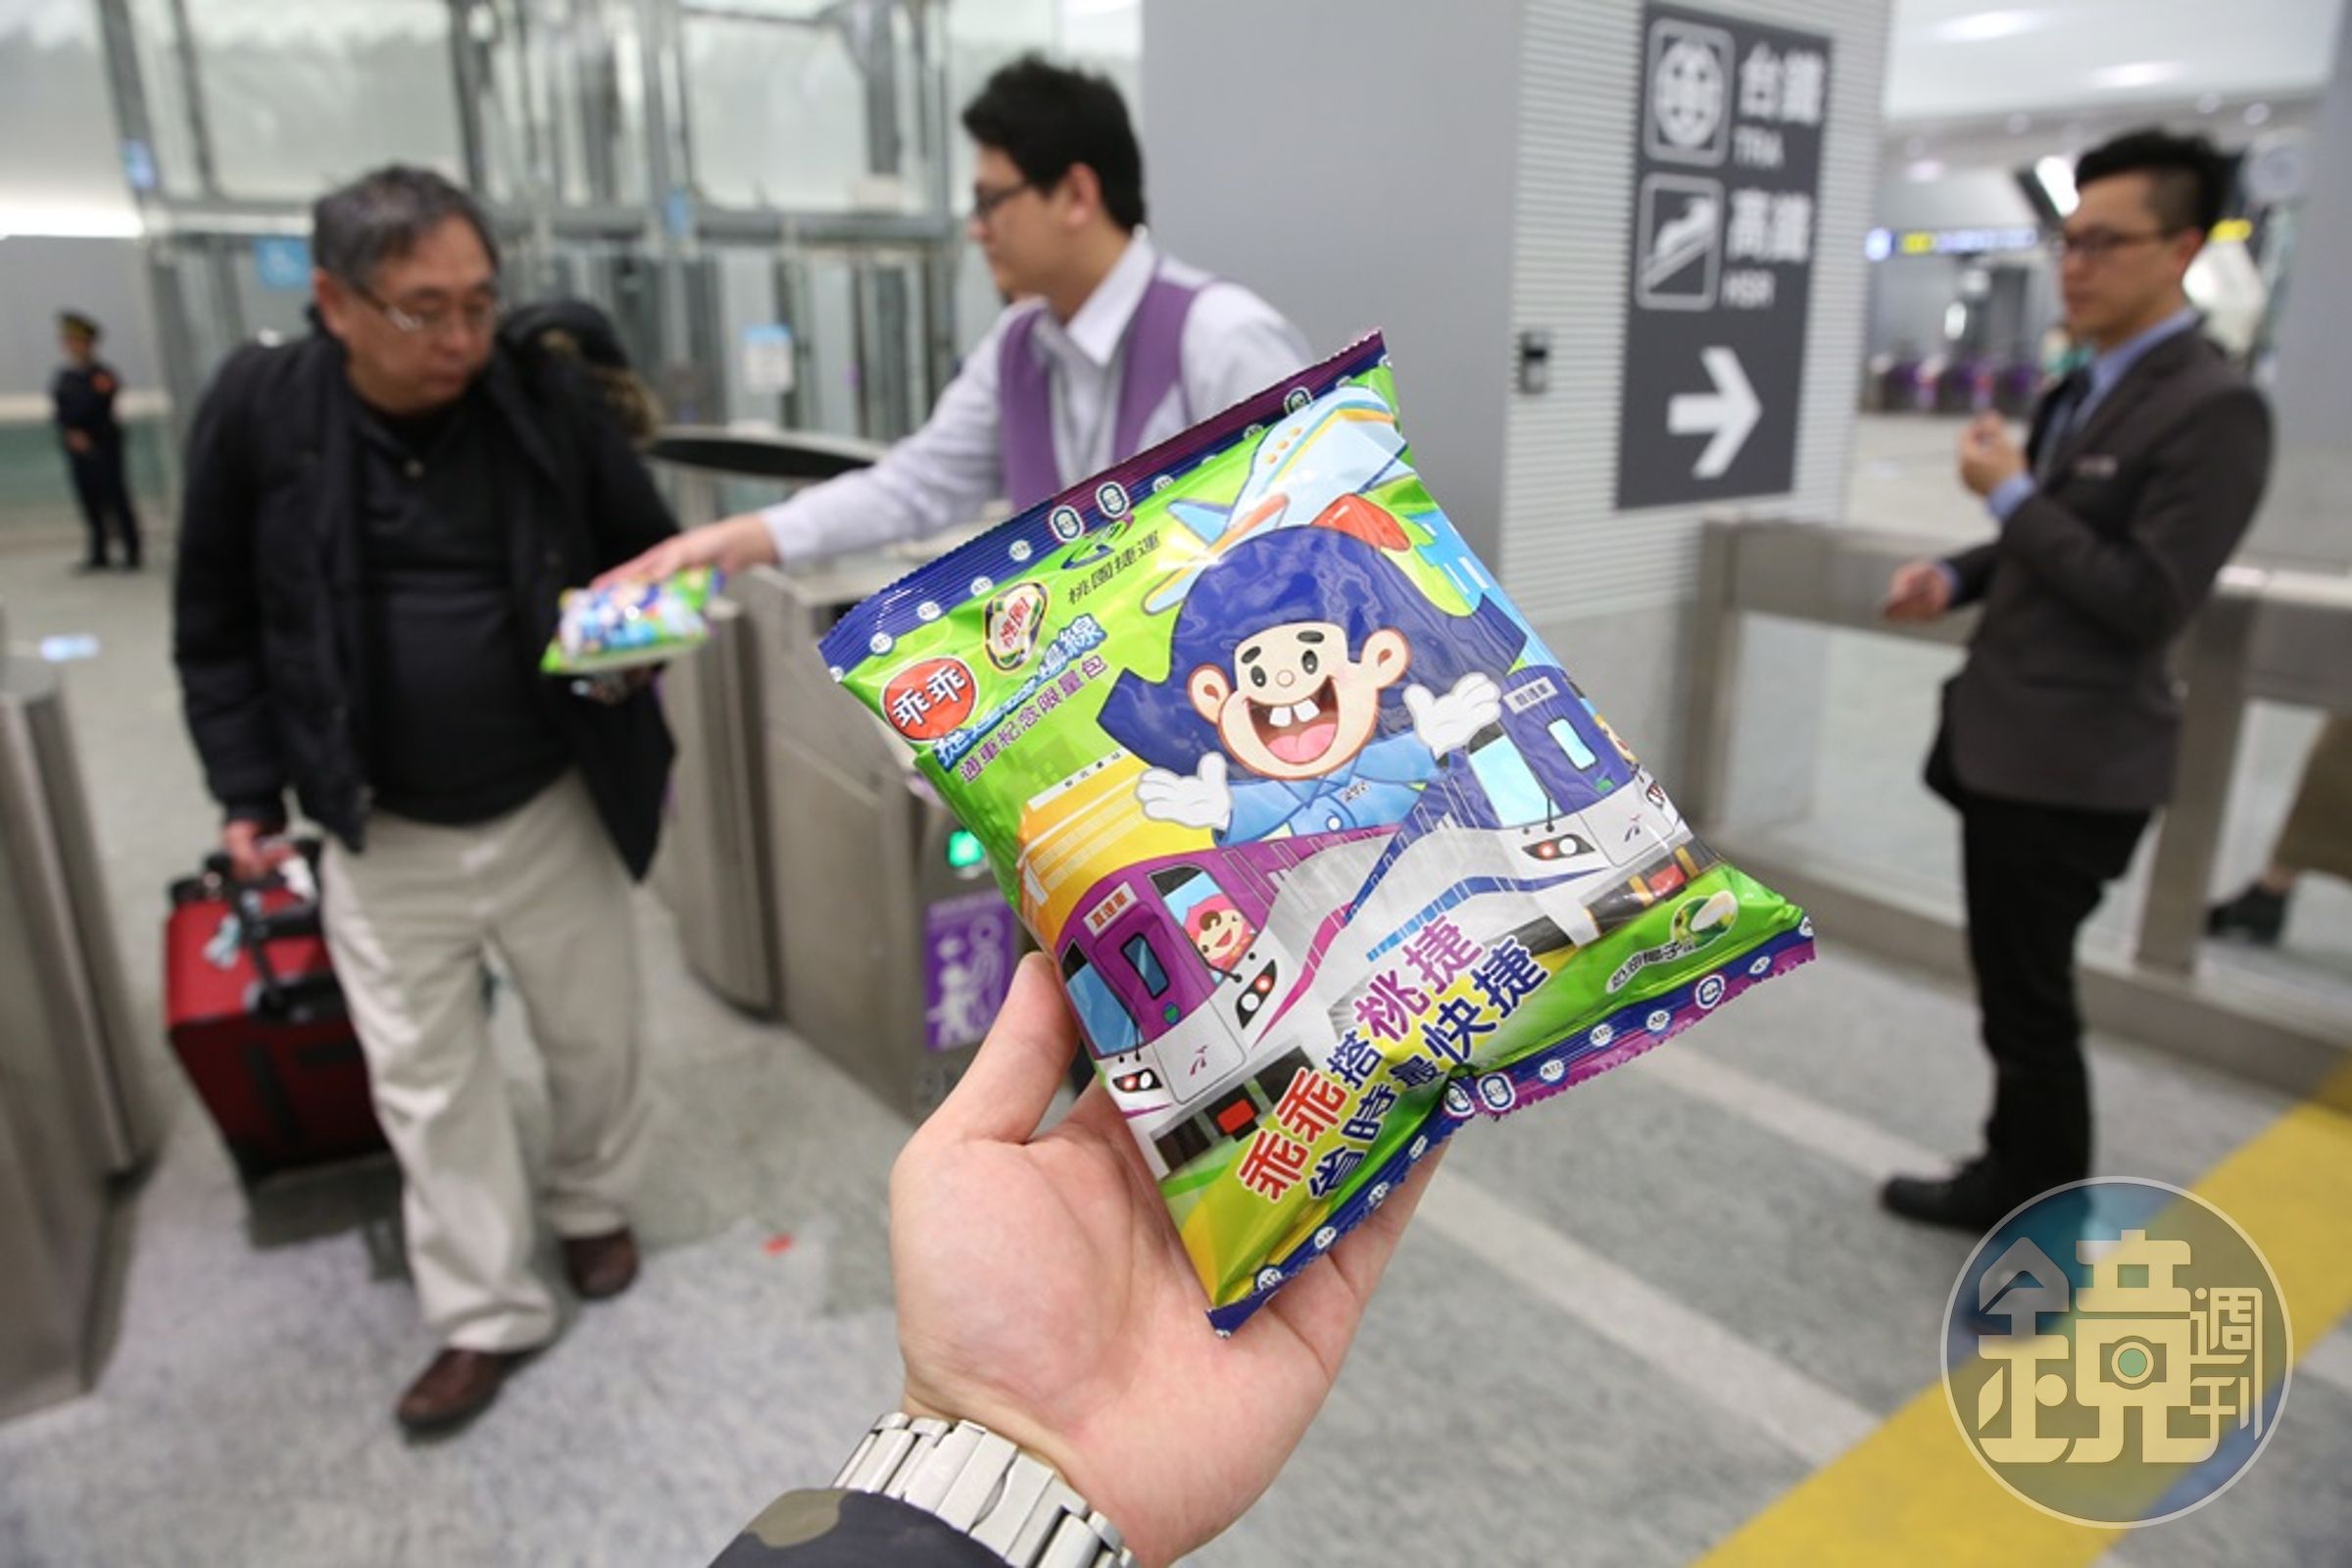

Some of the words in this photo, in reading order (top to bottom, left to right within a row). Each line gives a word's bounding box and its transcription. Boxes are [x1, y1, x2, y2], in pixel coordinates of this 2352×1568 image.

[1068, 530, 1160, 605] 桃園捷運
[893, 665, 967, 729] 乖乖
[960, 655, 1108, 783] 通車紀念限量包
[1240, 914, 1483, 1200] 乖乖搭桃捷
